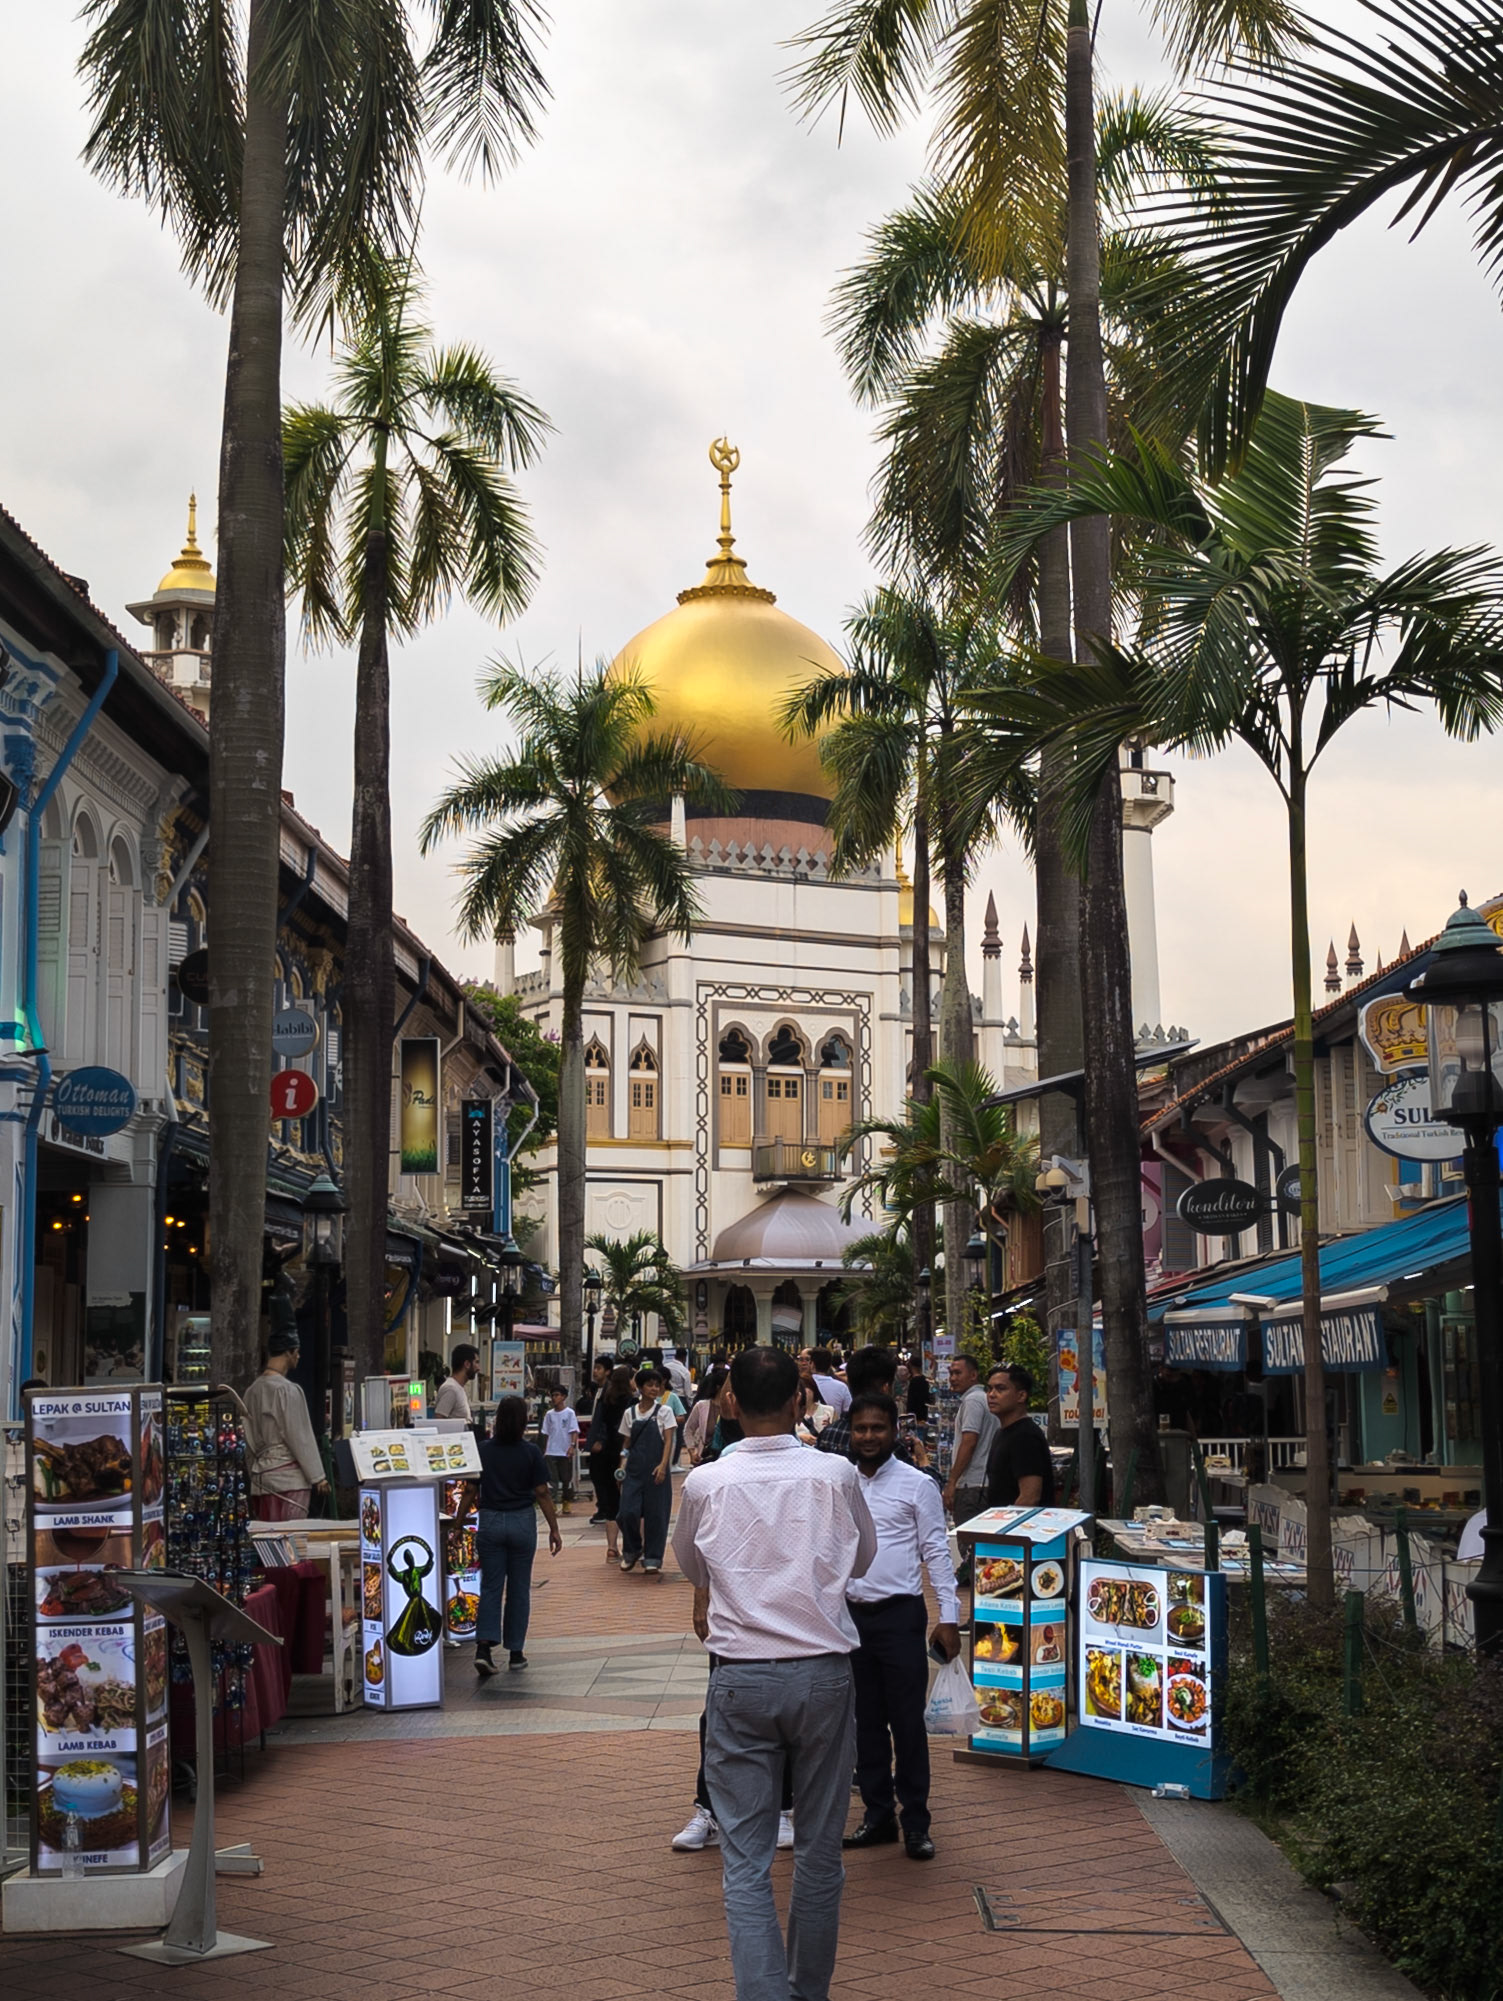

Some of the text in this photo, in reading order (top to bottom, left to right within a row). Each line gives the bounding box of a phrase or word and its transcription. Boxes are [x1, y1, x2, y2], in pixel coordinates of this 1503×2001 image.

[58, 1078, 129, 1103] Ottoman
[57, 1105, 130, 1117] TURKISH DELIGHTS
[1393, 1107, 1436, 1125] SUL
[1382, 1131, 1420, 1140] Traditional
[1422, 1130, 1449, 1138] Turkish
[472, 1120, 482, 1193] AYASOFYA
[1186, 1192, 1256, 1213] konditori
[1169, 1328, 1241, 1363] SULTAN RESTAURANT
[1266, 1312, 1380, 1368] SULTAN STAURANT
[32, 1402, 69, 1415] LEPAK
[72, 1403, 82, 1414] @
[85, 1401, 131, 1413] SULTAN
[53, 1514, 115, 1526] LAMB SHANK
[49, 1626, 125, 1638] ISKENDER KEBAB
[58, 1740, 117, 1751] LAMB KEBAB
